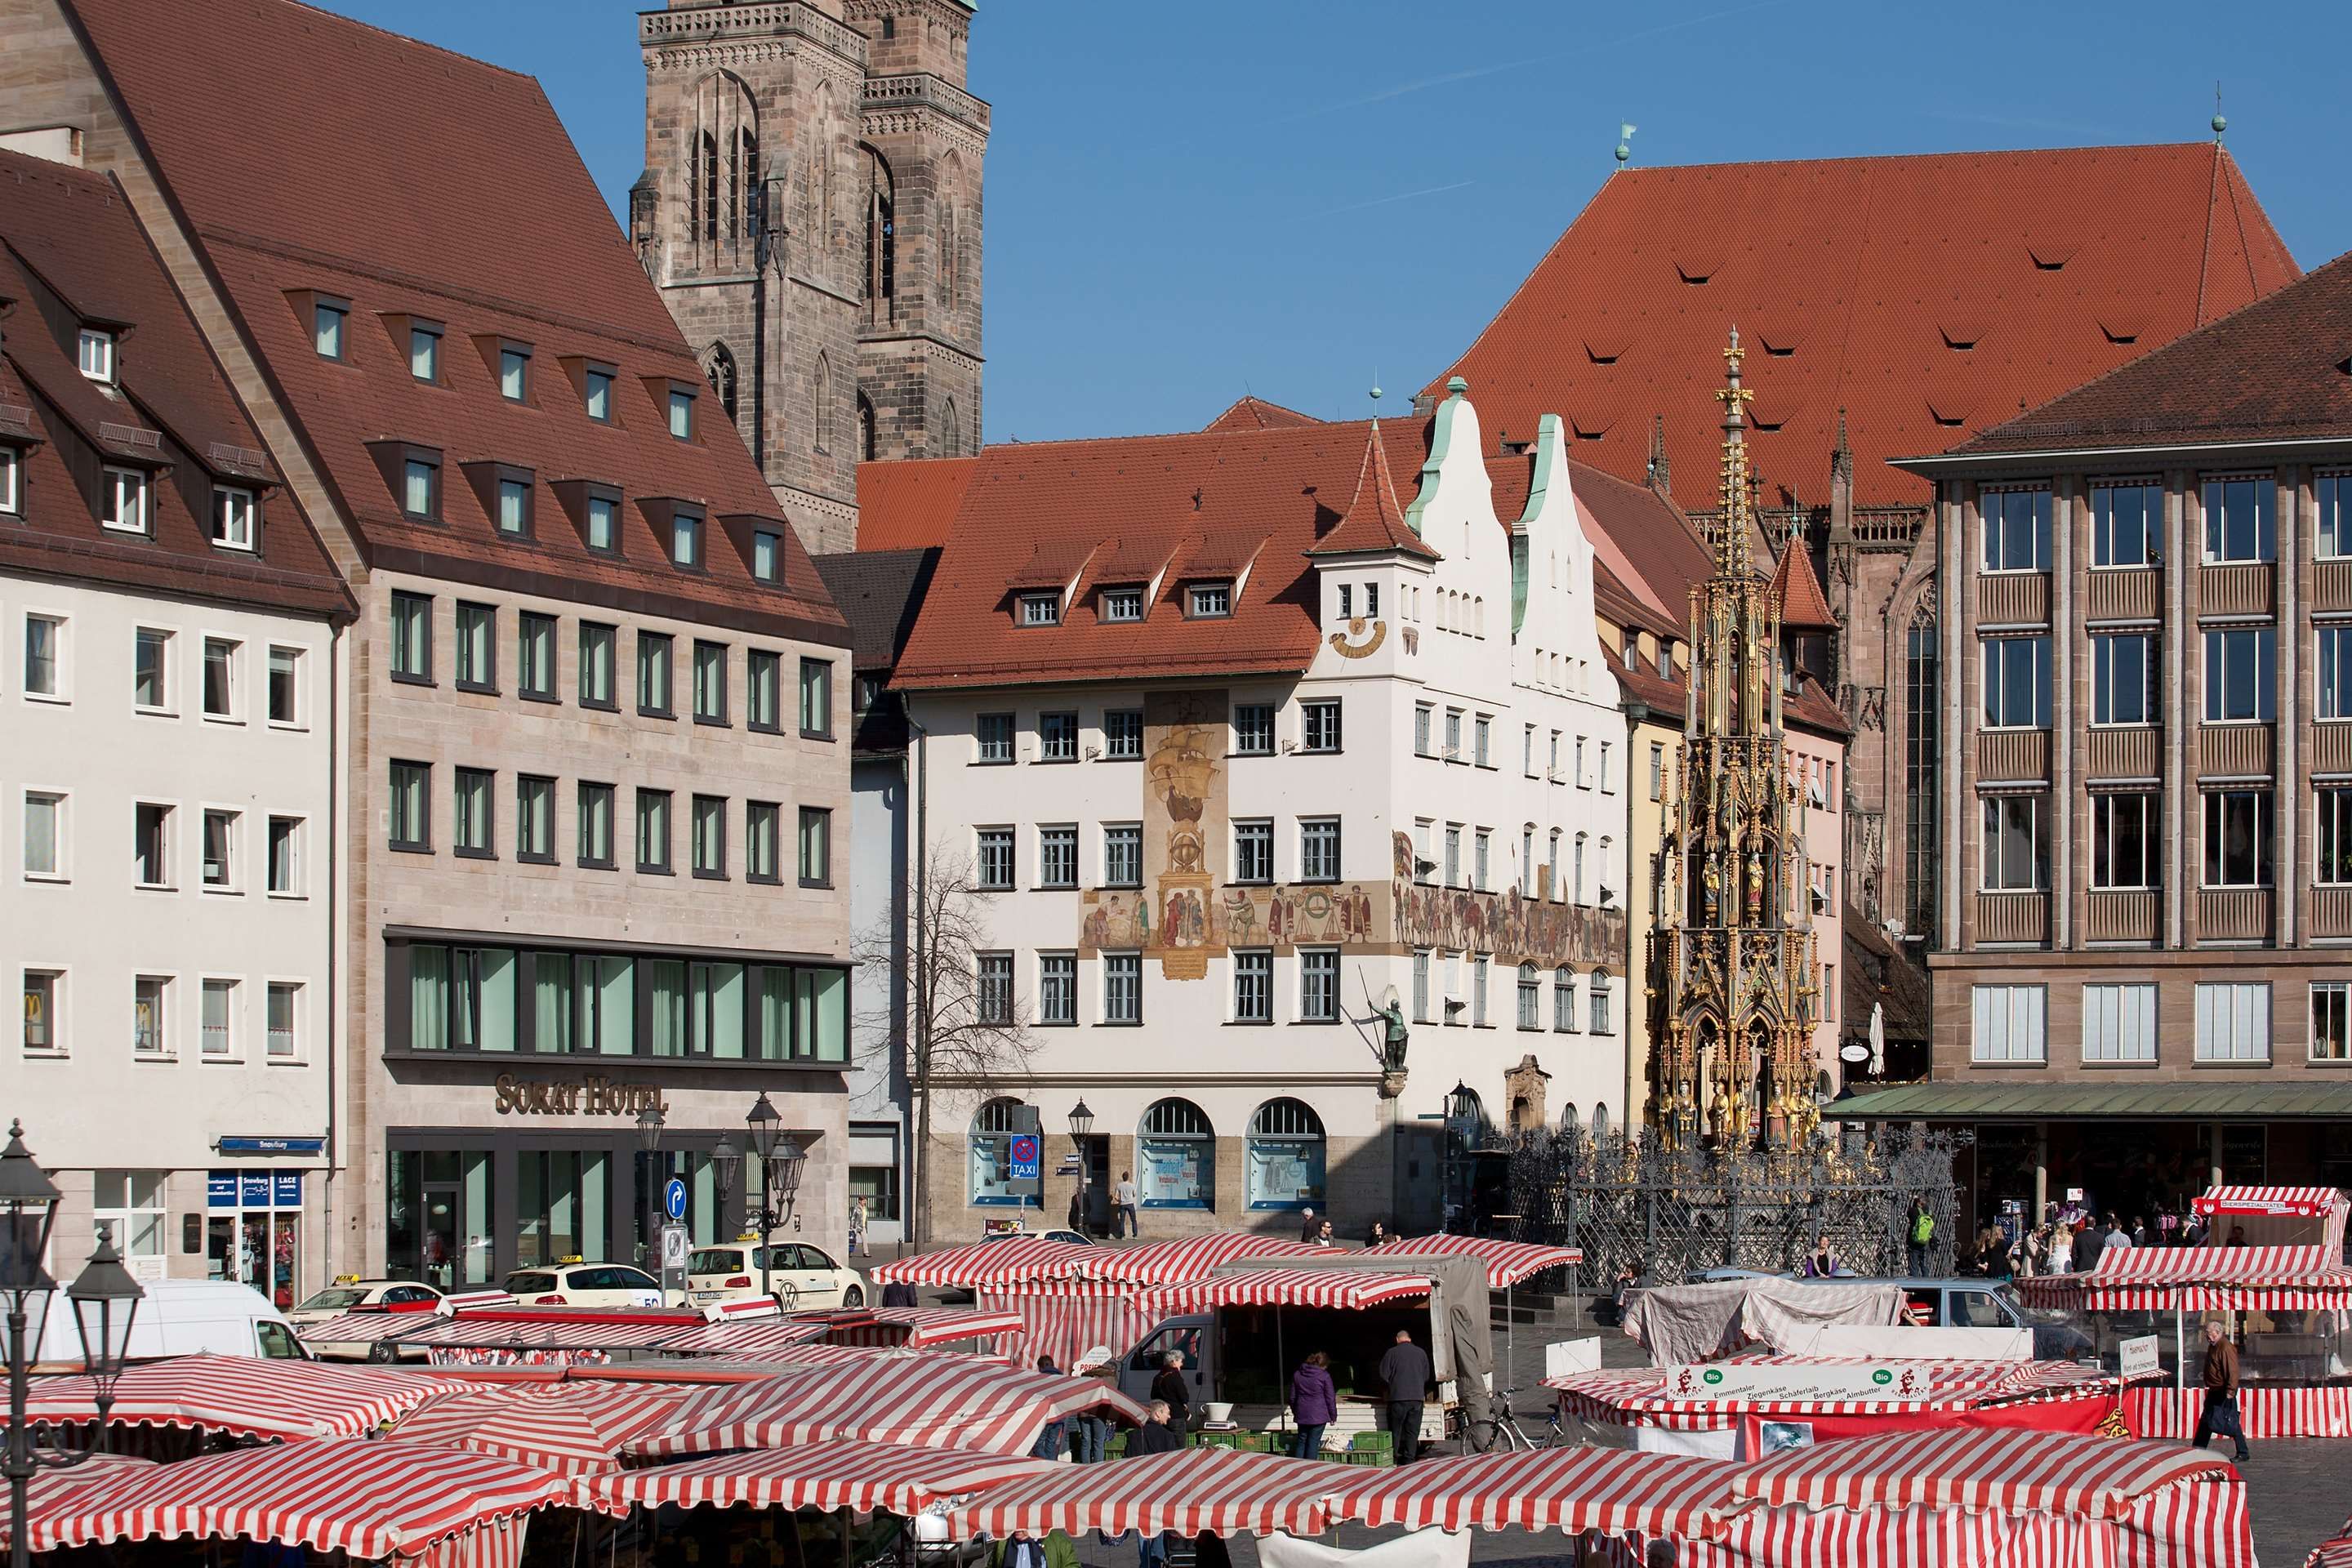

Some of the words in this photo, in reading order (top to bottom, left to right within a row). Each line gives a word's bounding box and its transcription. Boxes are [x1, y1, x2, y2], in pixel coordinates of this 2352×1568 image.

[496, 1072, 581, 1115] SORAT
[584, 1076, 669, 1116] HOTEL
[1013, 1165, 1036, 1174] TAXI
[1714, 1385, 1755, 1398] Emmentaler
[1846, 1387, 1882, 1399] Almbutter
